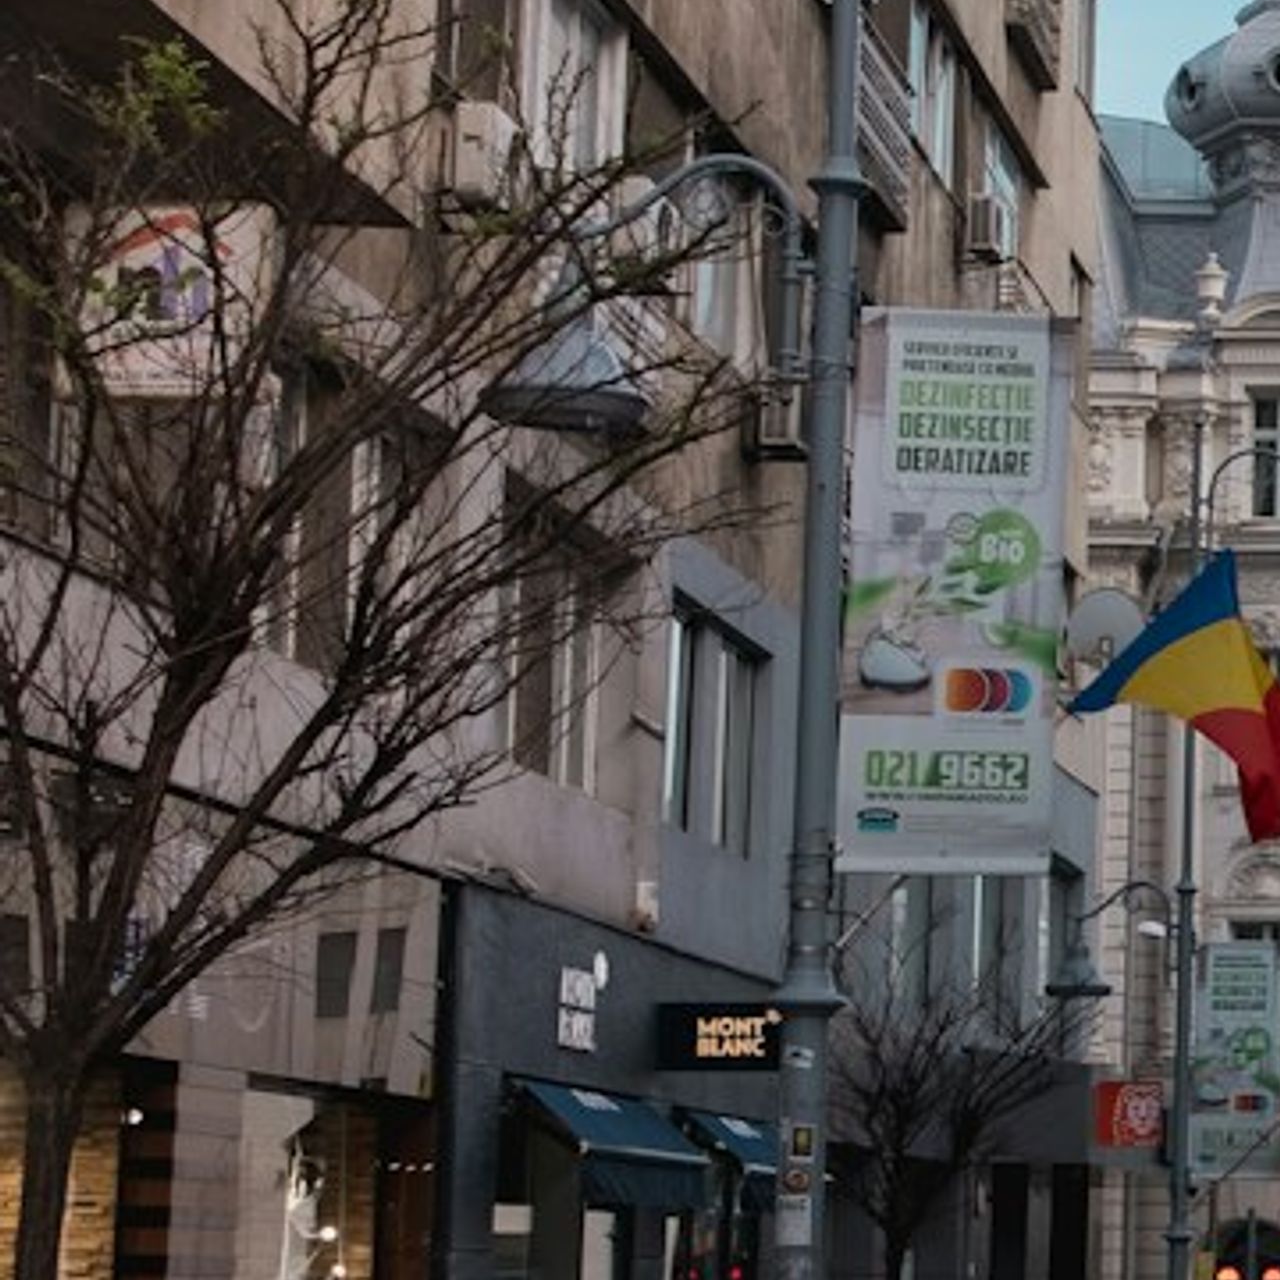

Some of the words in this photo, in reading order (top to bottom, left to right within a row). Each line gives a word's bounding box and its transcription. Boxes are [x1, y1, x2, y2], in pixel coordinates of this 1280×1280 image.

[895, 446, 1033, 477] DERATIZARE
[696, 1016, 766, 1036] MONT
[696, 1037, 766, 1058] BLANC
